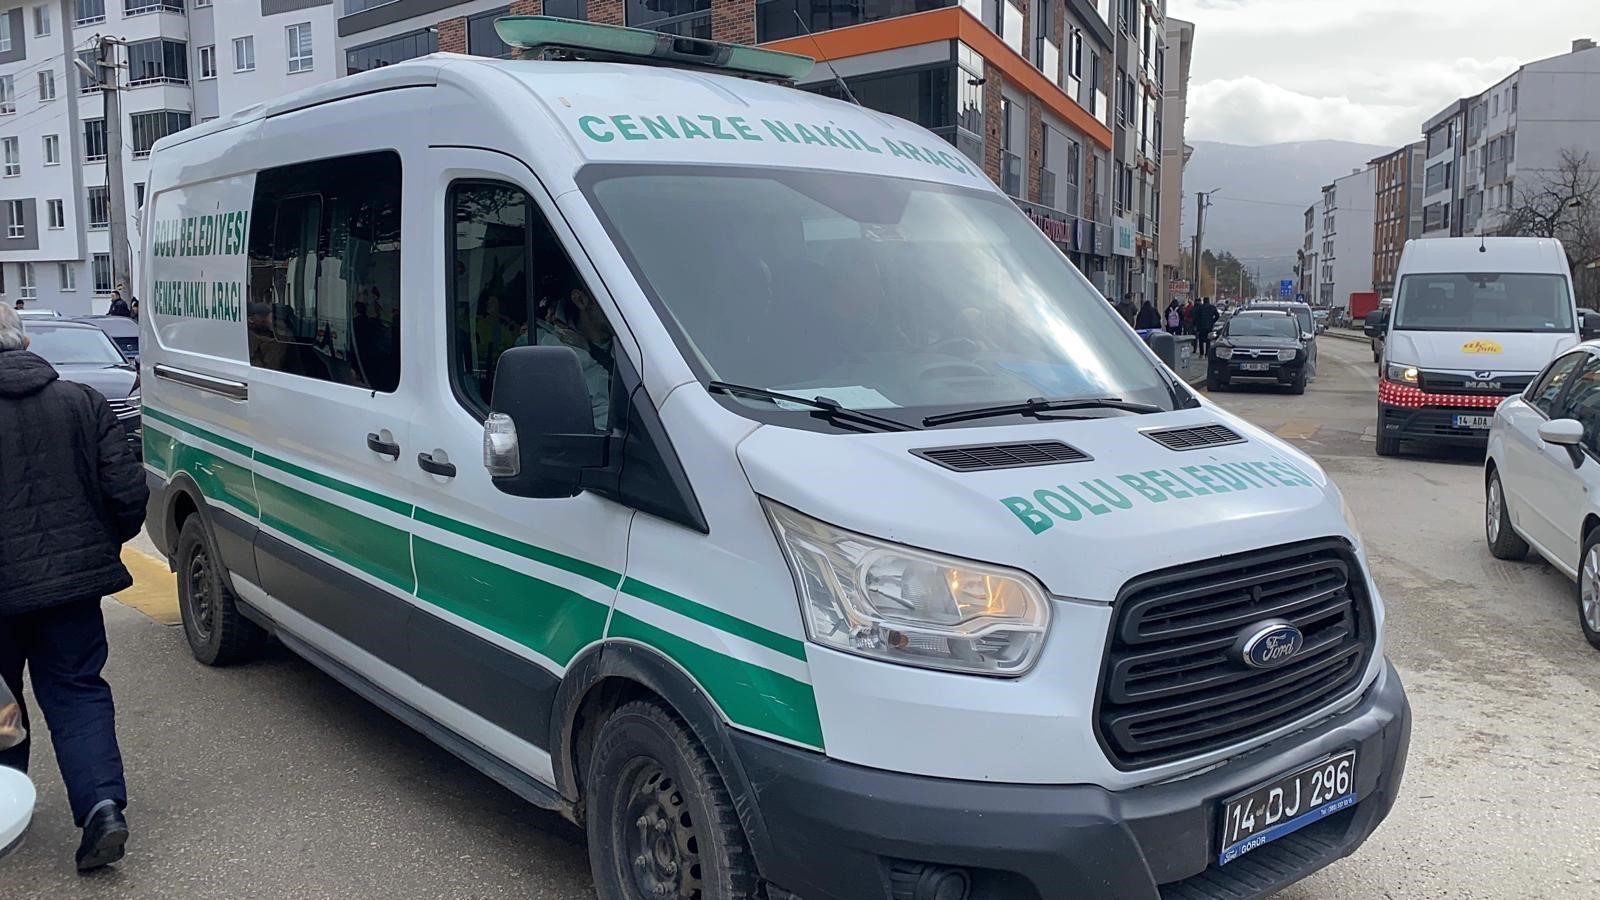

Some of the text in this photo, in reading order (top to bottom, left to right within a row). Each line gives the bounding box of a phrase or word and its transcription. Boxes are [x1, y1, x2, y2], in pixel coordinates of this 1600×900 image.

[578, 114, 977, 178] CENAZE NAKİL ARACI
[154, 219, 178, 258] BOLU
[154, 270, 241, 322] CENAZE NAKİL ARACI
[1465, 381, 1501, 389] MAN
[1459, 416, 1488, 426] 14 ADA
[1000, 478, 1133, 535] BOLU
[1262, 633, 1294, 661] Ford
[1232, 760, 1350, 842] 14 DJ 296
[1241, 836, 1266, 854] GÖRÜR
